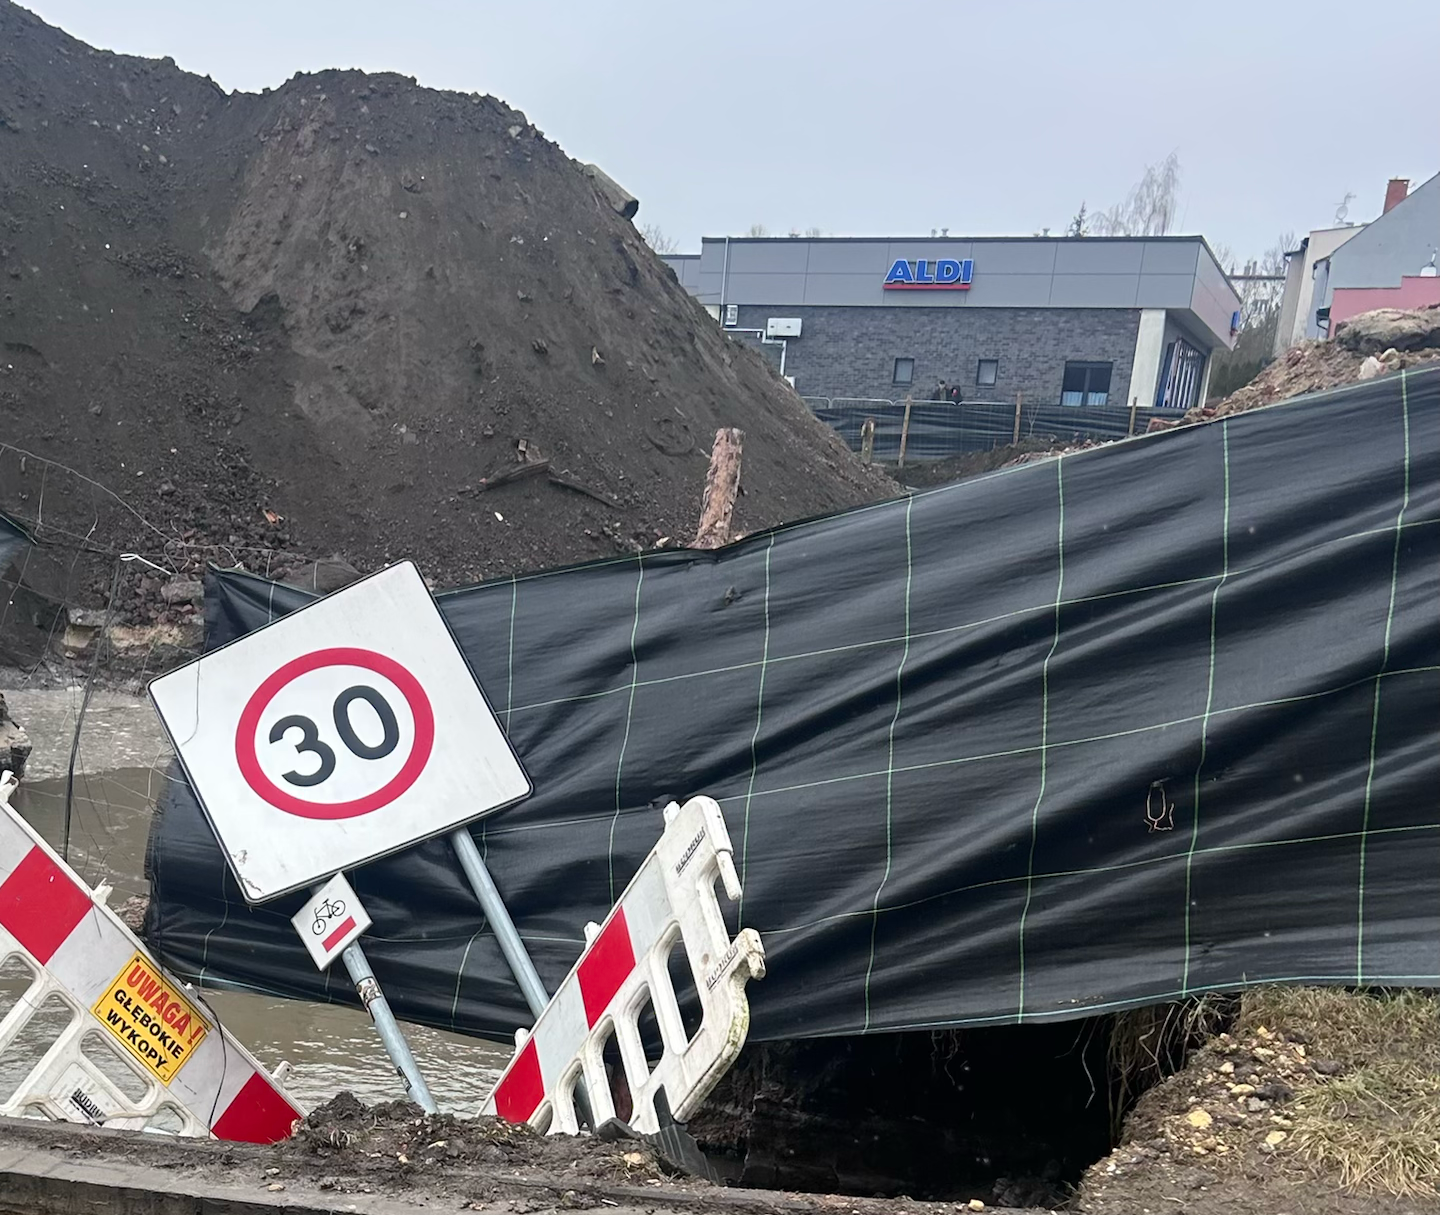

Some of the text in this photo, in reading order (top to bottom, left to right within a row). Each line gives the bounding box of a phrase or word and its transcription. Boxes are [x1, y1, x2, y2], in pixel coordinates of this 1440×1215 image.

[883, 258, 974, 284] ALDI
[269, 685, 399, 787] 30
[106, 1008, 168, 1069] WYKOPY
[114, 989, 184, 1059] GŁĘBOKIE
[72, 1088, 107, 1118] BUDRU
